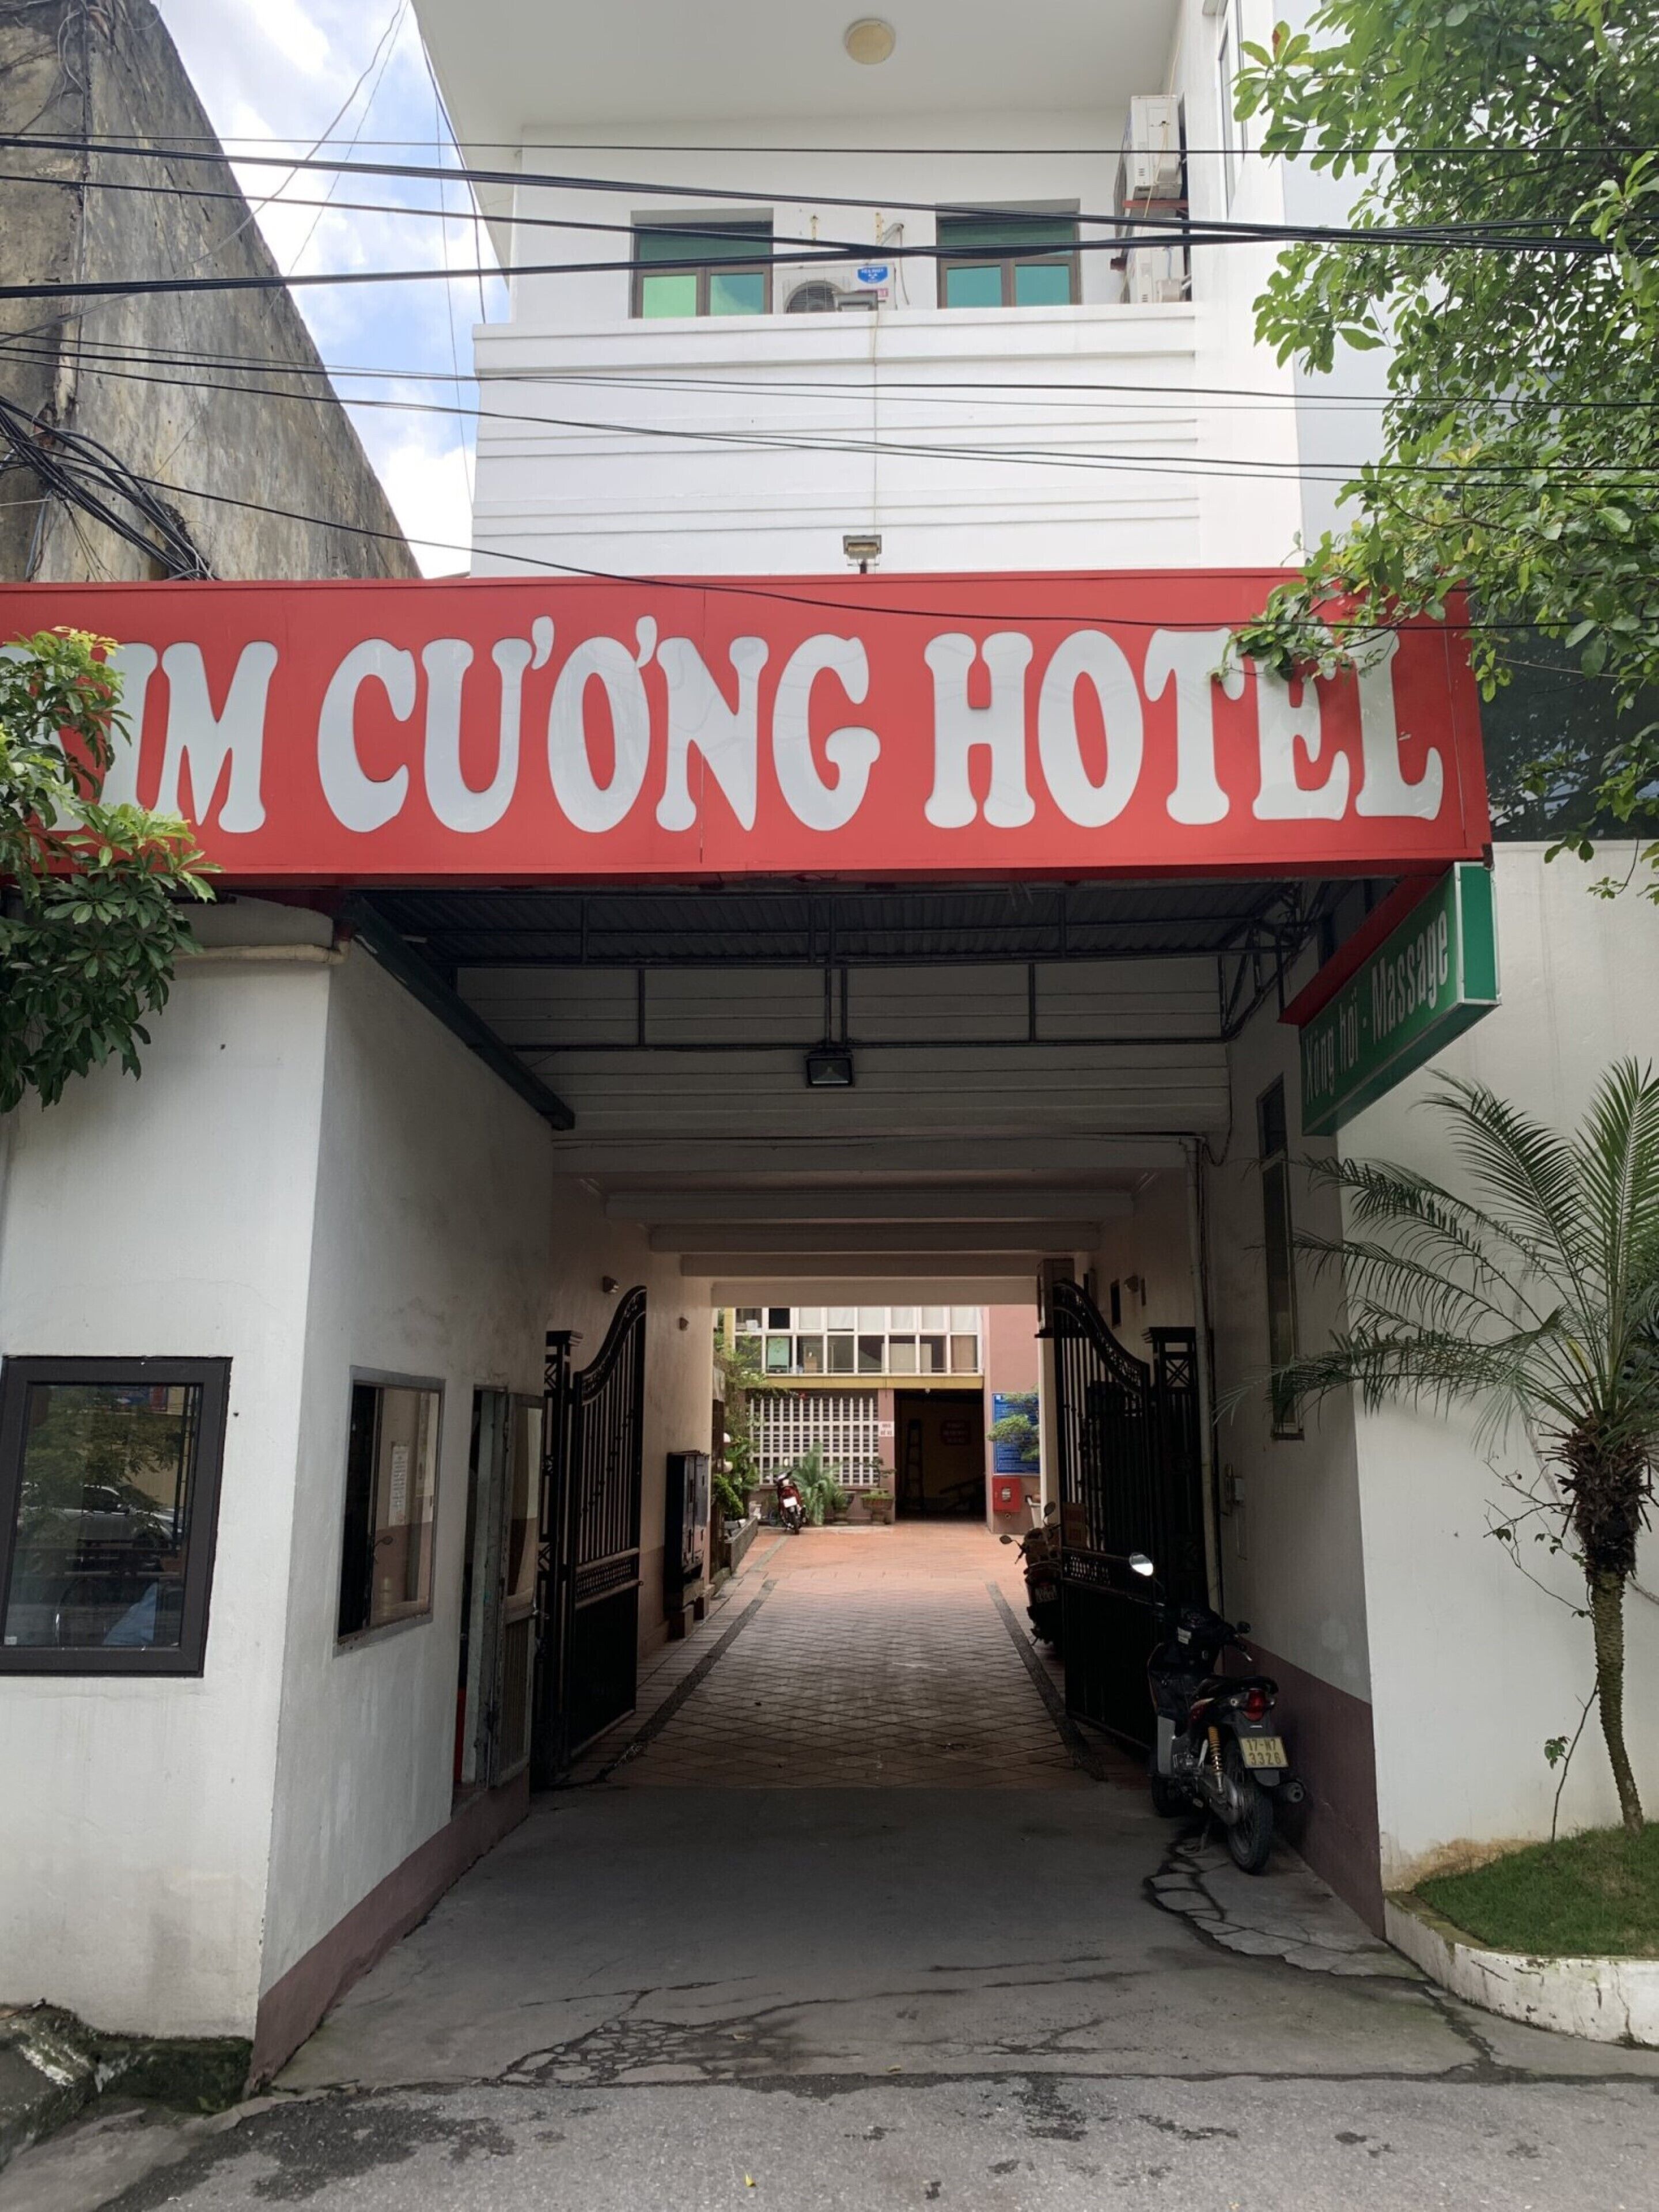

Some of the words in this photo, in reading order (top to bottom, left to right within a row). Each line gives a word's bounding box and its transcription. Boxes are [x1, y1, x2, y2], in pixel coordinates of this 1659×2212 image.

[317, 615, 880, 833] CƯƠNG
[925, 628, 1443, 828] HOTEL
[1372, 910, 1448, 1045] Massage
